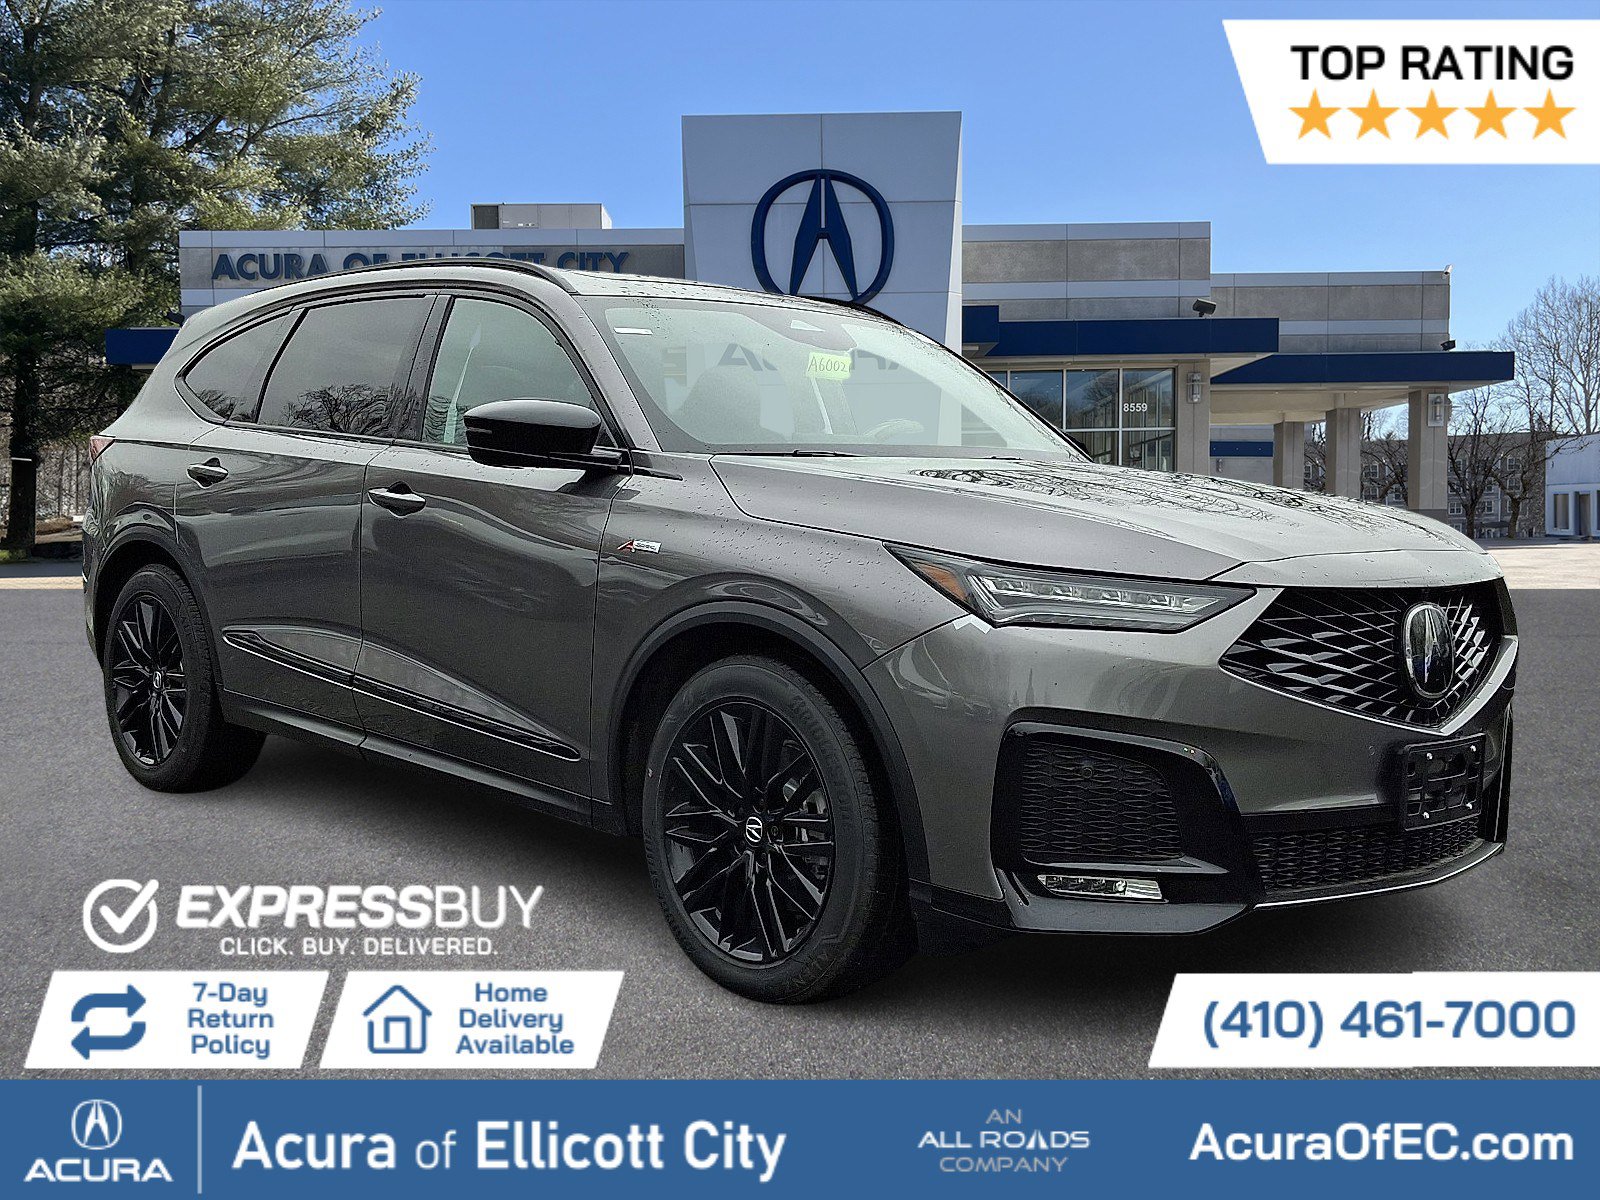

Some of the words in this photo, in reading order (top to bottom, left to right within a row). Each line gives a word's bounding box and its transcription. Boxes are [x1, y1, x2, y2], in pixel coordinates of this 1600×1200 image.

[211, 253, 330, 280] ACURA
[556, 251, 629, 274] CITY
[1122, 402, 1148, 413] 8559
